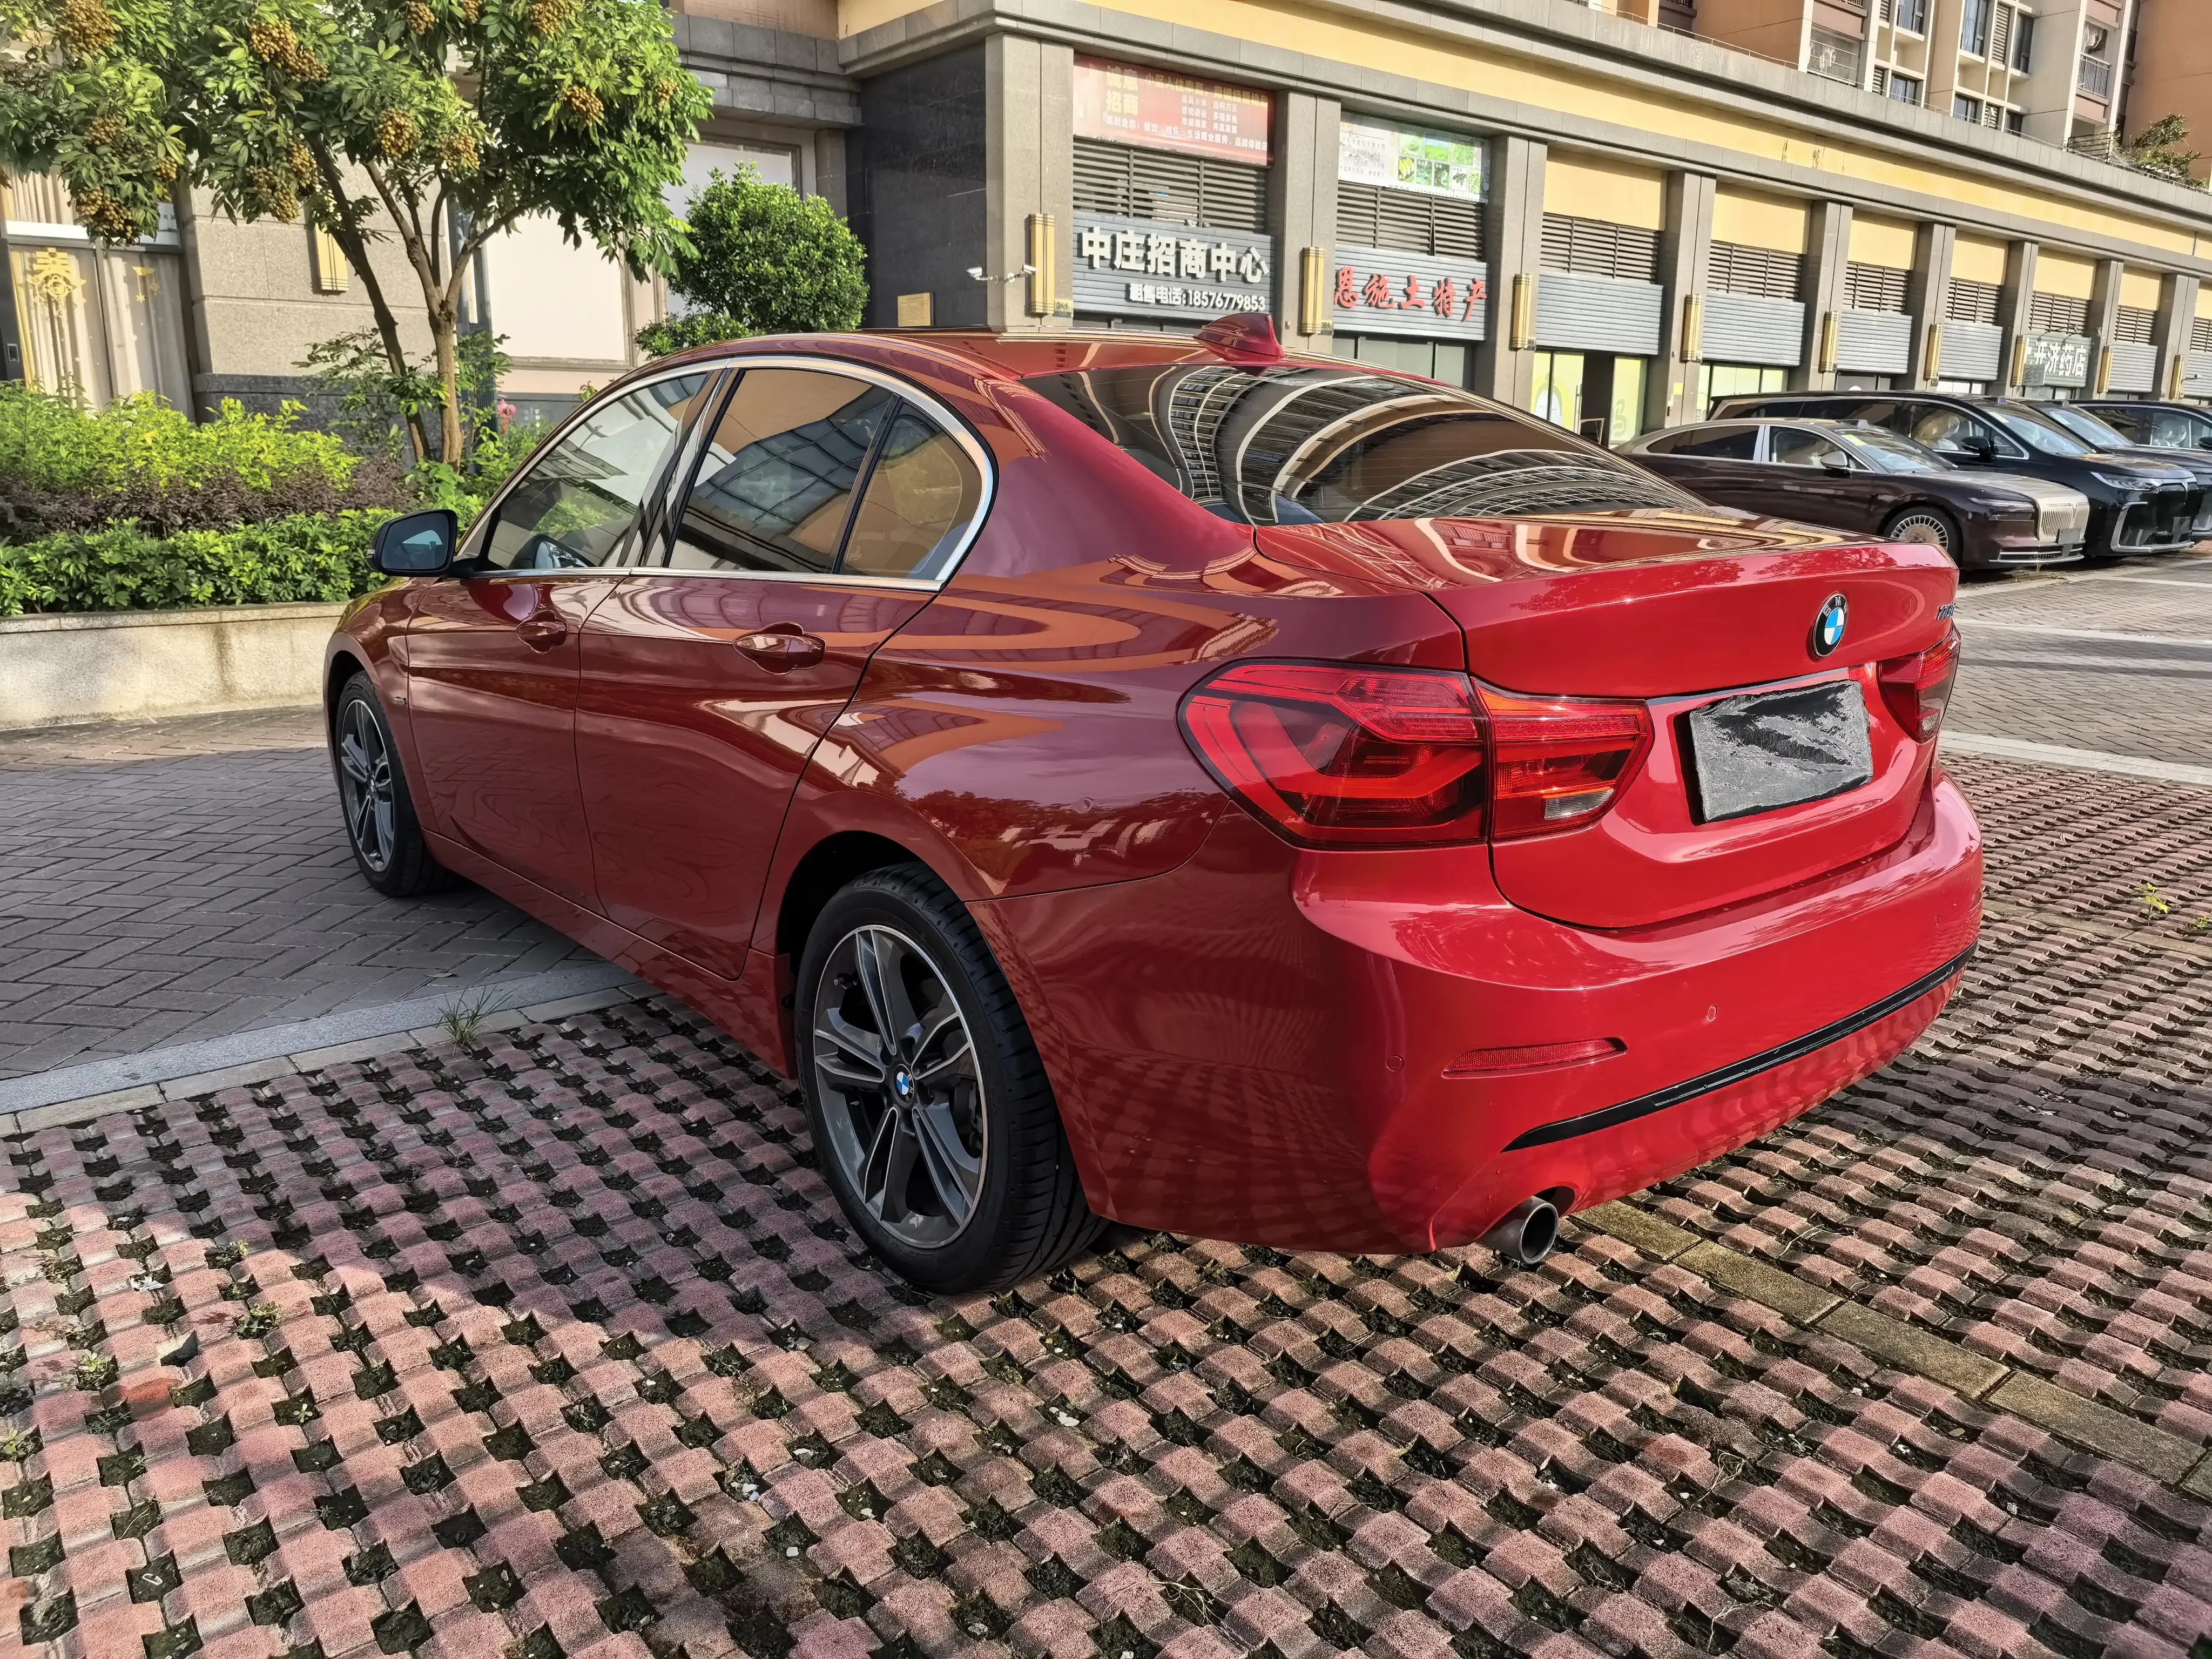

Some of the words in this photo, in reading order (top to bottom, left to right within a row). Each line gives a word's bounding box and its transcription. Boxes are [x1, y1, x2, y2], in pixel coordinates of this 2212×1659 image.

[1082, 226, 1270, 283] 中庄招商中心
[1333, 265, 1487, 321] 恩施土特产
